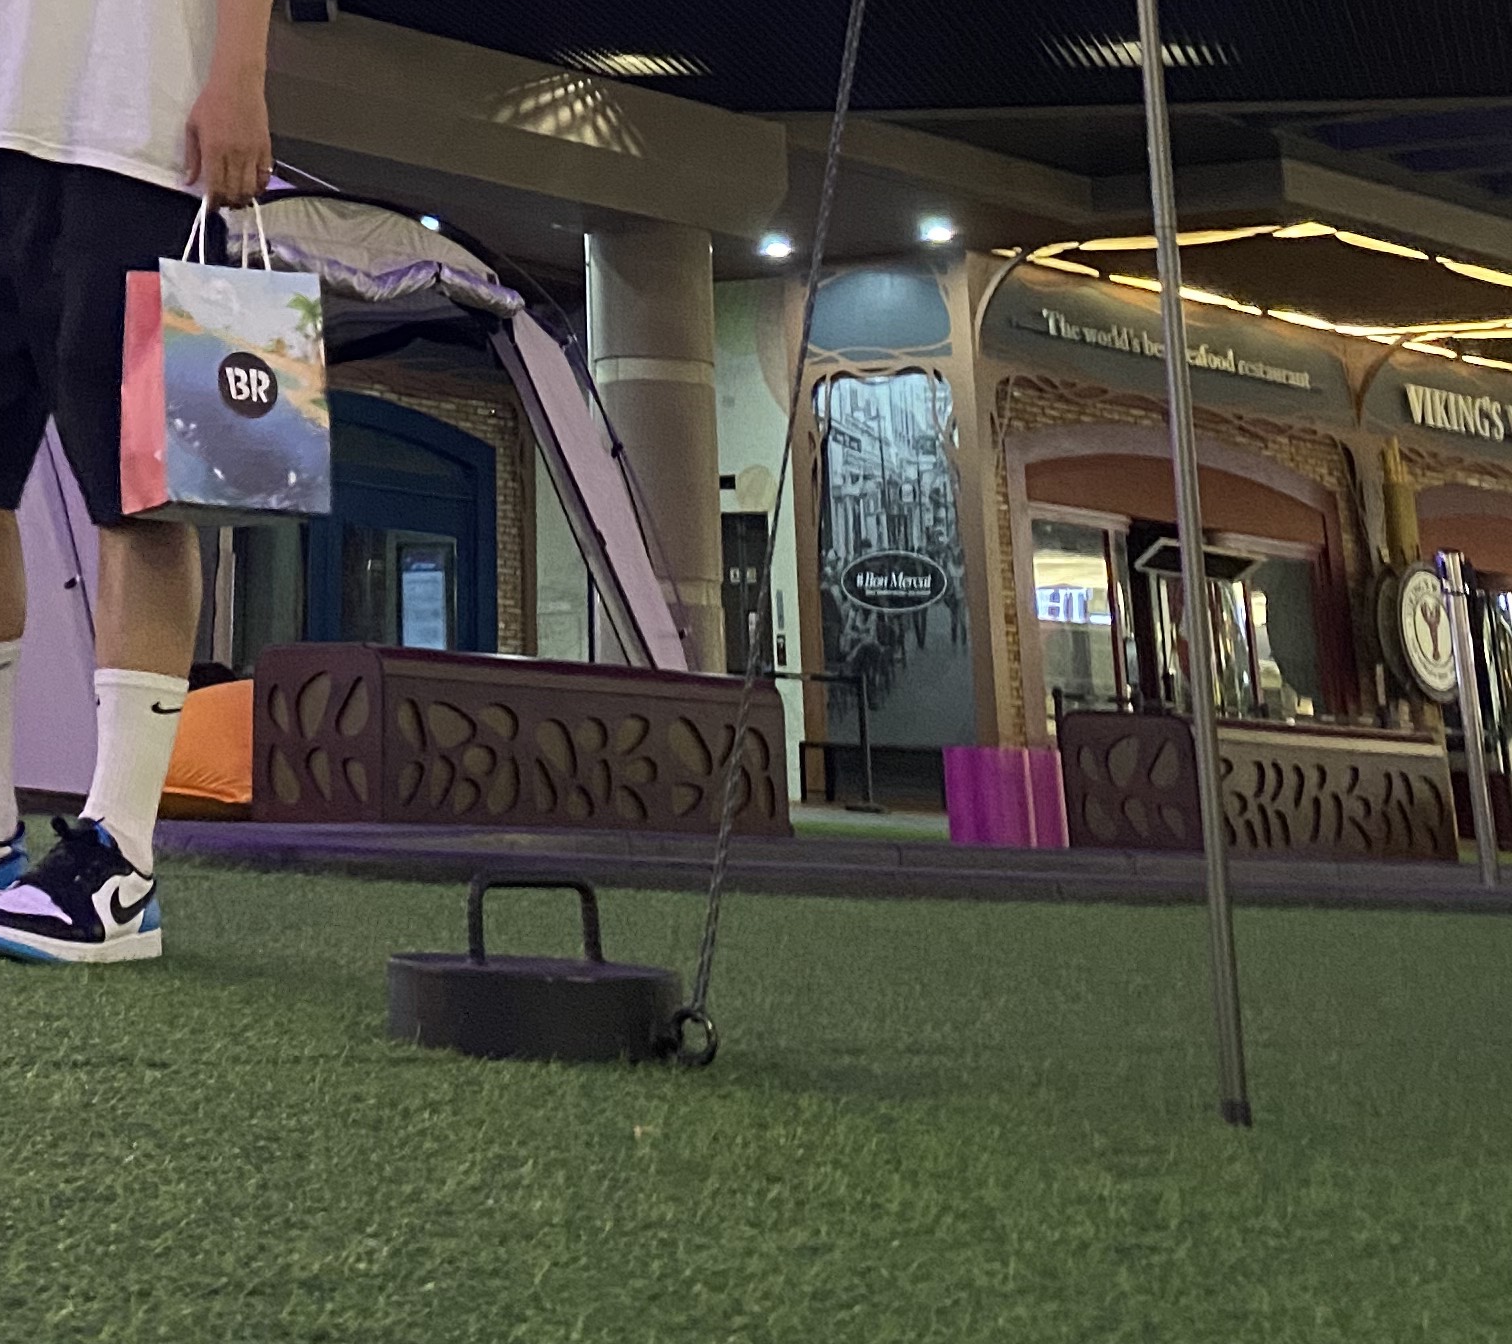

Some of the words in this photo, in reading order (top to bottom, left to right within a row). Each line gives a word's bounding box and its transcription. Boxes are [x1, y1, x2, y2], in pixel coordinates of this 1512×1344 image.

[1041, 308, 1080, 340] The
[1084, 324, 1140, 354] world's
[225, 366, 271, 403] BR
